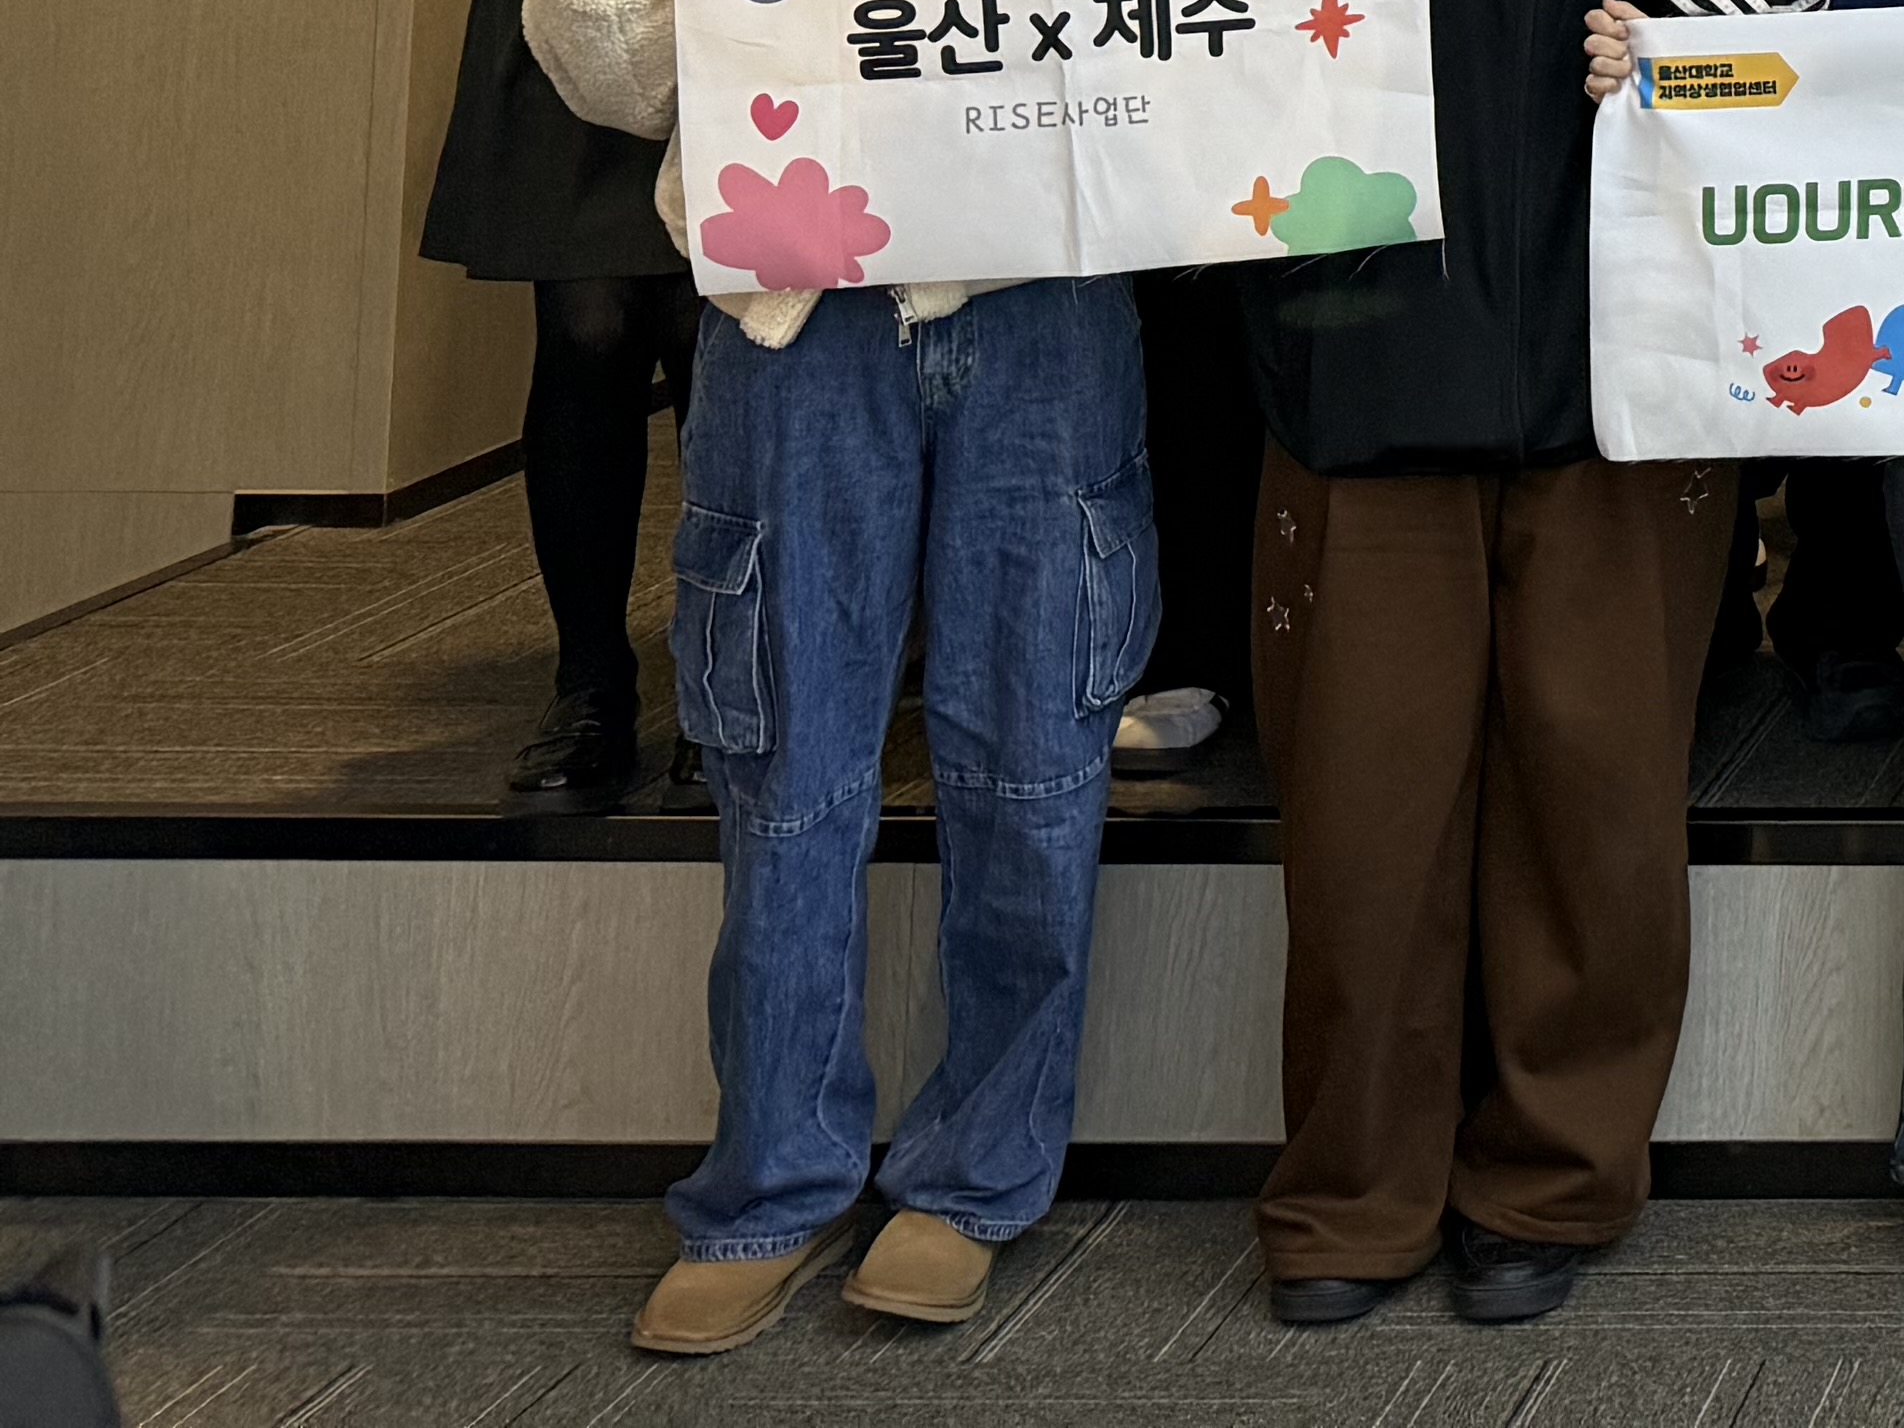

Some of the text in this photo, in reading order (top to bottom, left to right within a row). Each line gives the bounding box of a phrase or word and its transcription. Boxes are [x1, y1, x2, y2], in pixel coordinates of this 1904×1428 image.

[1658, 62, 1735, 82] 울산대학교
[1658, 80, 1778, 101] 지역상생협업센터
[964, 94, 1152, 135] RISE사업단
